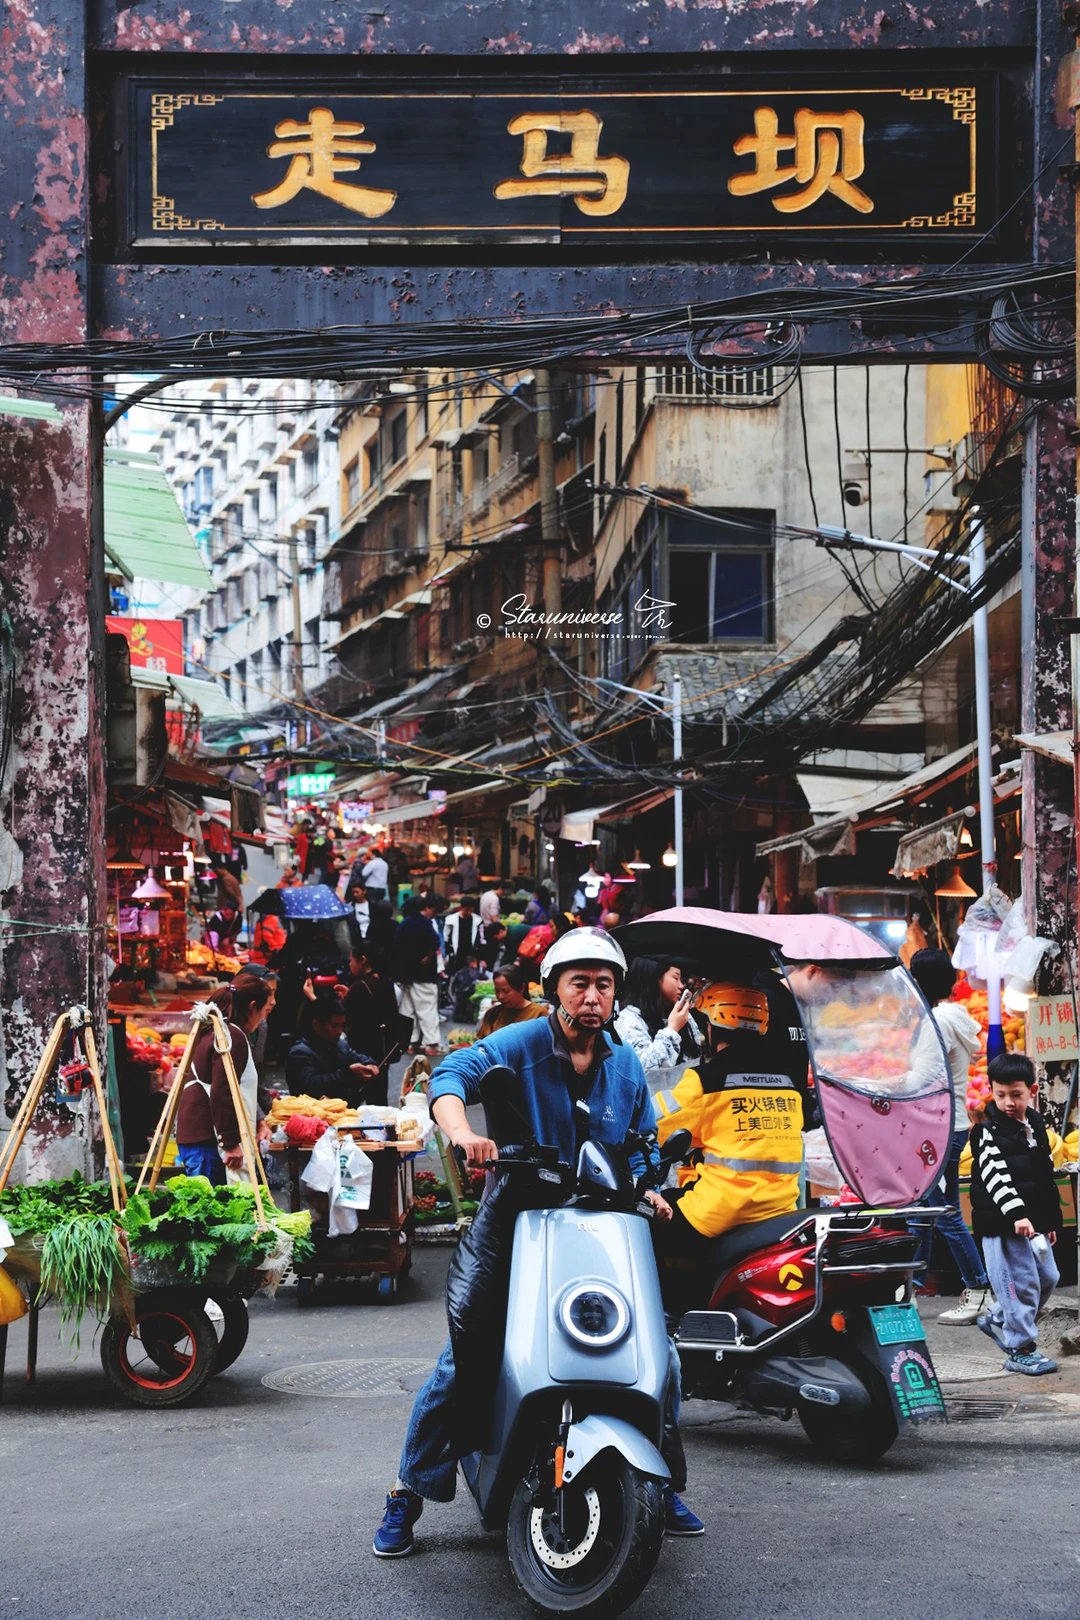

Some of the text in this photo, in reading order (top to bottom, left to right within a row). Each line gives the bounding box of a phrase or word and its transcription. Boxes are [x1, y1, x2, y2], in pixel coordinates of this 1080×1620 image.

[251, 106, 876, 219] 走马坝
[742, 1076, 783, 1084] MEITUAN
[730, 1096, 798, 1114] 买火锅食材
[734, 1116, 793, 1132] 上美团外卖
